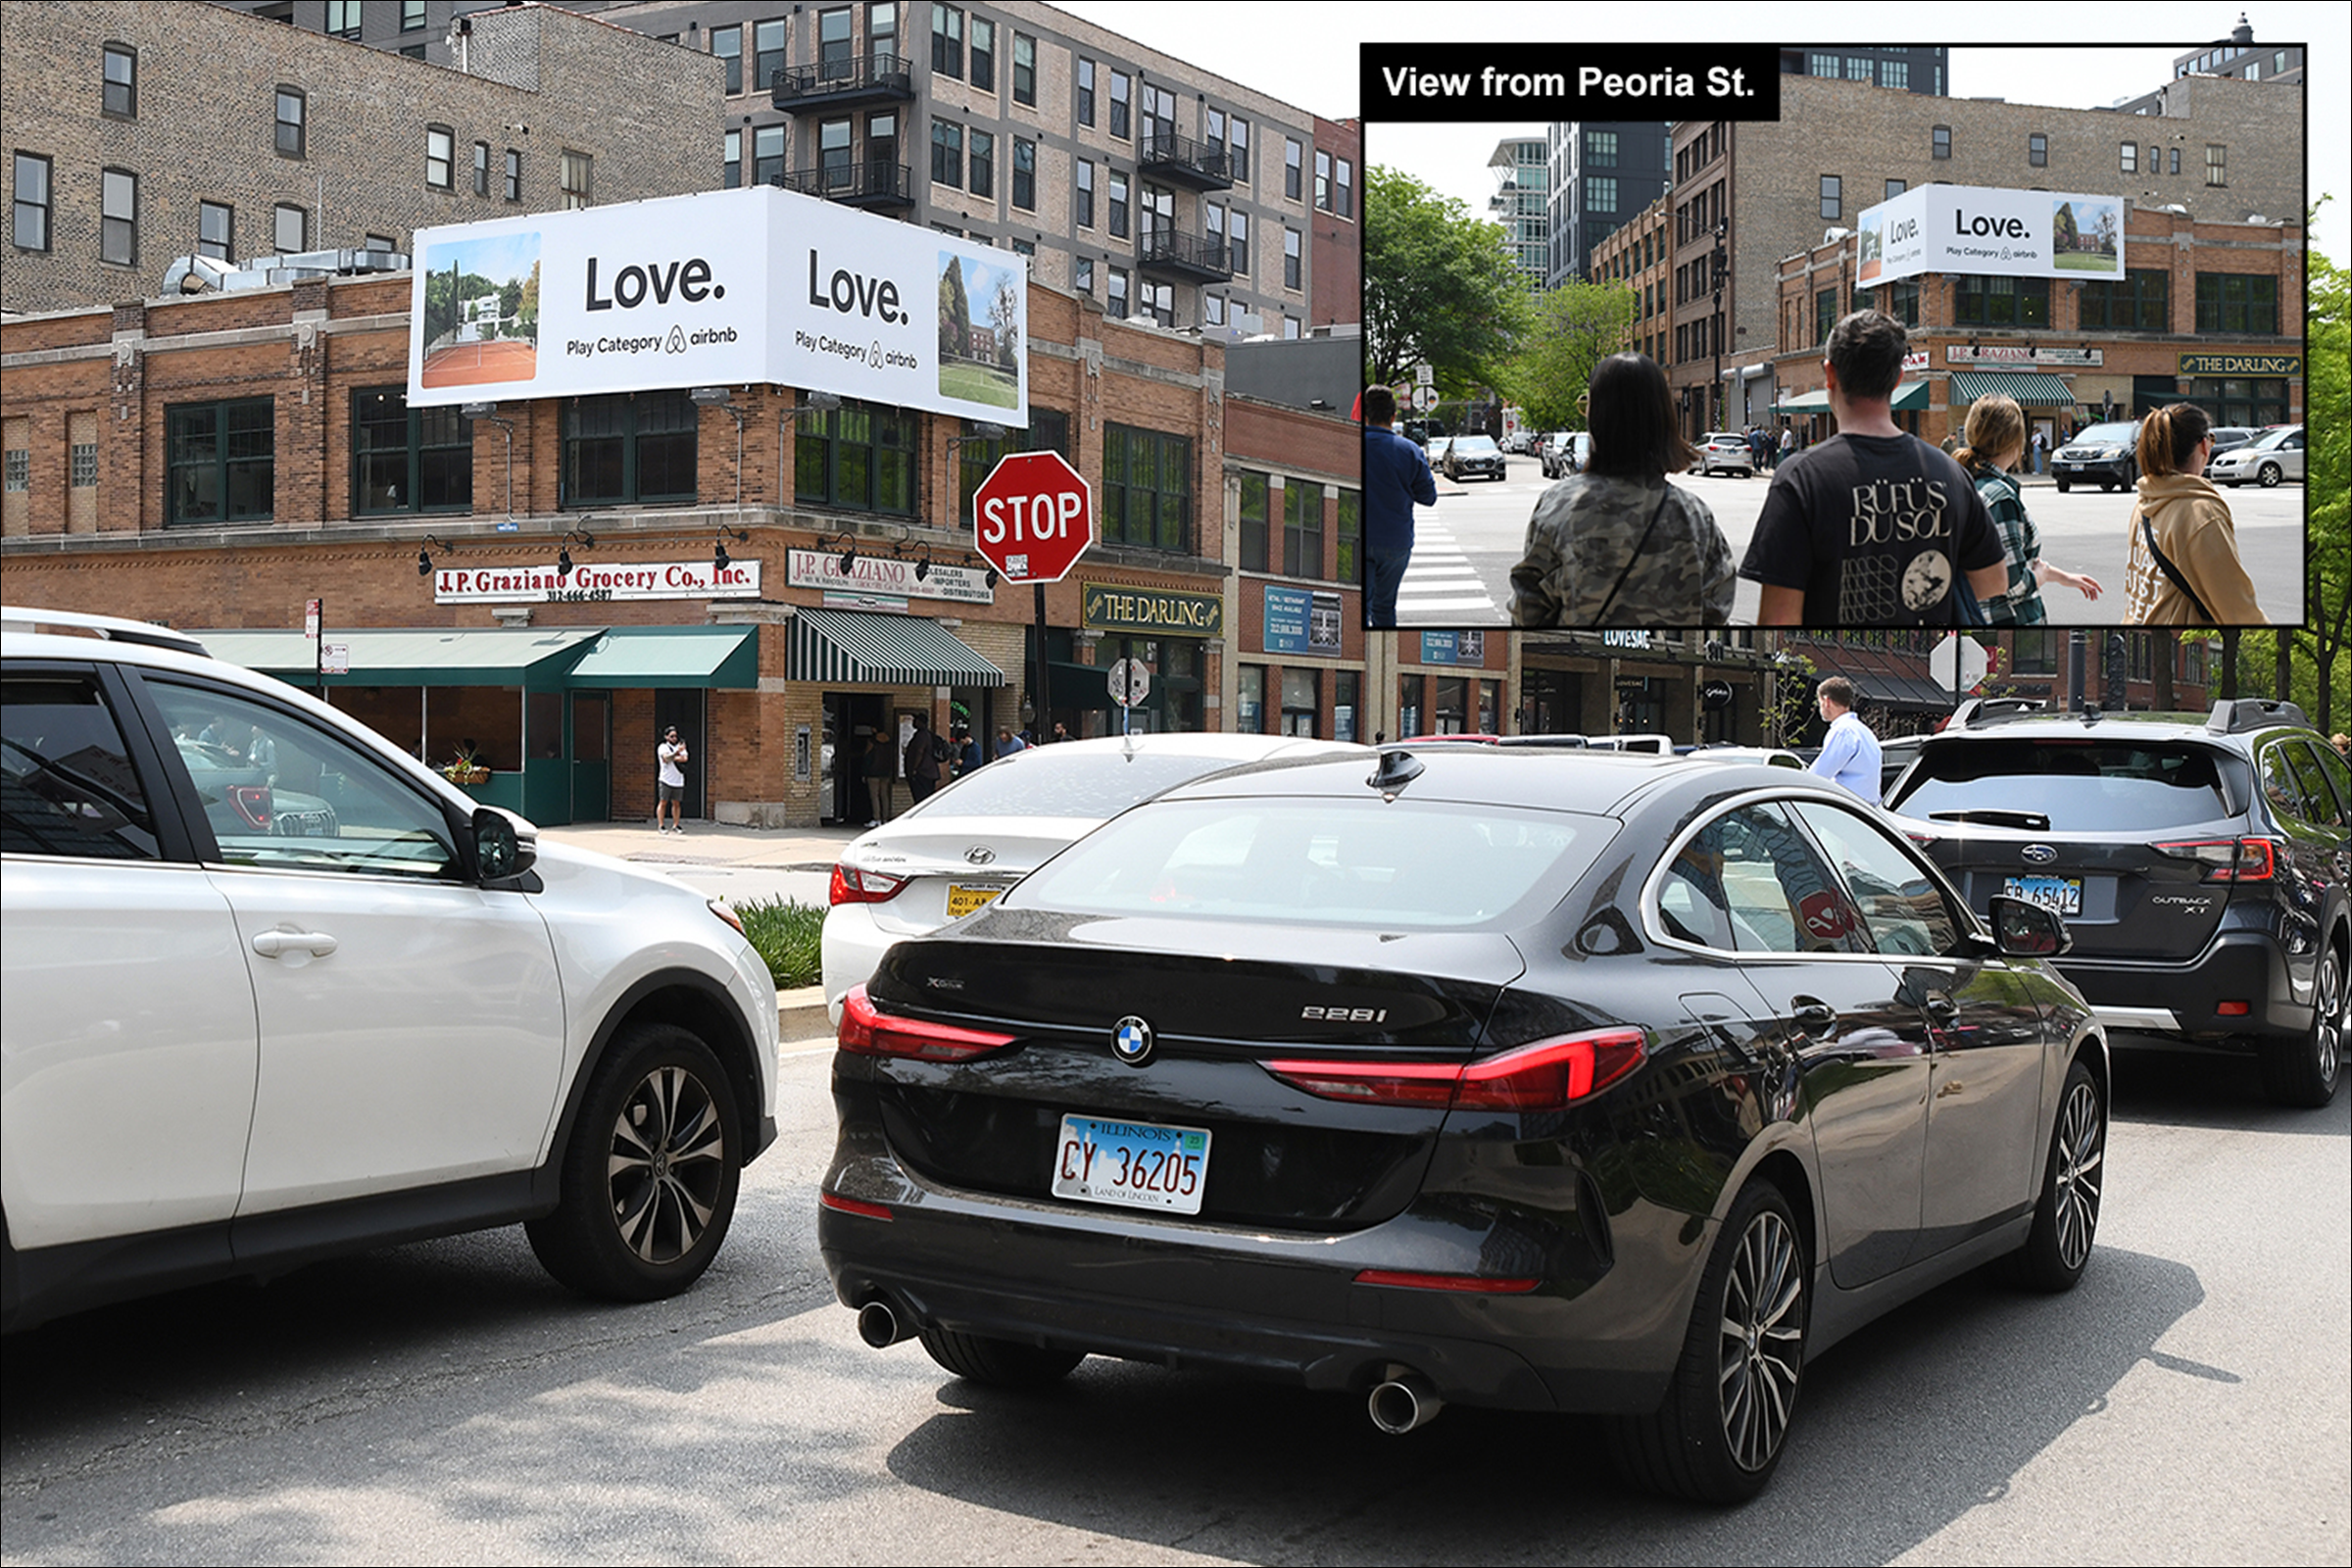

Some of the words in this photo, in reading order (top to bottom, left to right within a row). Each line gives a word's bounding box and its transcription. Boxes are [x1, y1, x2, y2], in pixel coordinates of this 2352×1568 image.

[1956, 209, 2031, 239] Love.
[585, 257, 726, 313] Love.
[808, 248, 909, 325] Love.
[566, 340, 595, 356] Play
[597, 333, 663, 355] Category
[689, 325, 737, 345] airbnb
[795, 330, 817, 352] Play
[818, 336, 867, 363] Category
[885, 351, 917, 370] airbnb
[2196, 357, 2223, 371] THE
[2225, 358, 2285, 372] DARLING
[983, 492, 1082, 544] STOP
[1850, 513, 1893, 546] DU
[1896, 509, 1952, 541] SOL
[439, 572, 471, 593] J.P.
[475, 569, 566, 592] Graziano
[575, 567, 657, 590] Grocery
[665, 565, 706, 588] Co.,
[712, 563, 751, 586] Inc.
[794, 553, 815, 581] J.P.
[1103, 594, 1135, 621] THE
[1137, 596, 1204, 626] DARLING
[2032, 886, 2080, 907] 65412
[2152, 896, 2213, 906] OUTBACK
[2183, 906, 2209, 914] XT
[1102, 1123, 1171, 1142] ILLINOIS
[1061, 1140, 1098, 1182] CY
[1112, 1147, 1200, 1196] 36205
[1095, 1186, 1116, 1198] LAND
[1128, 1191, 1159, 1203] LINCOLN
